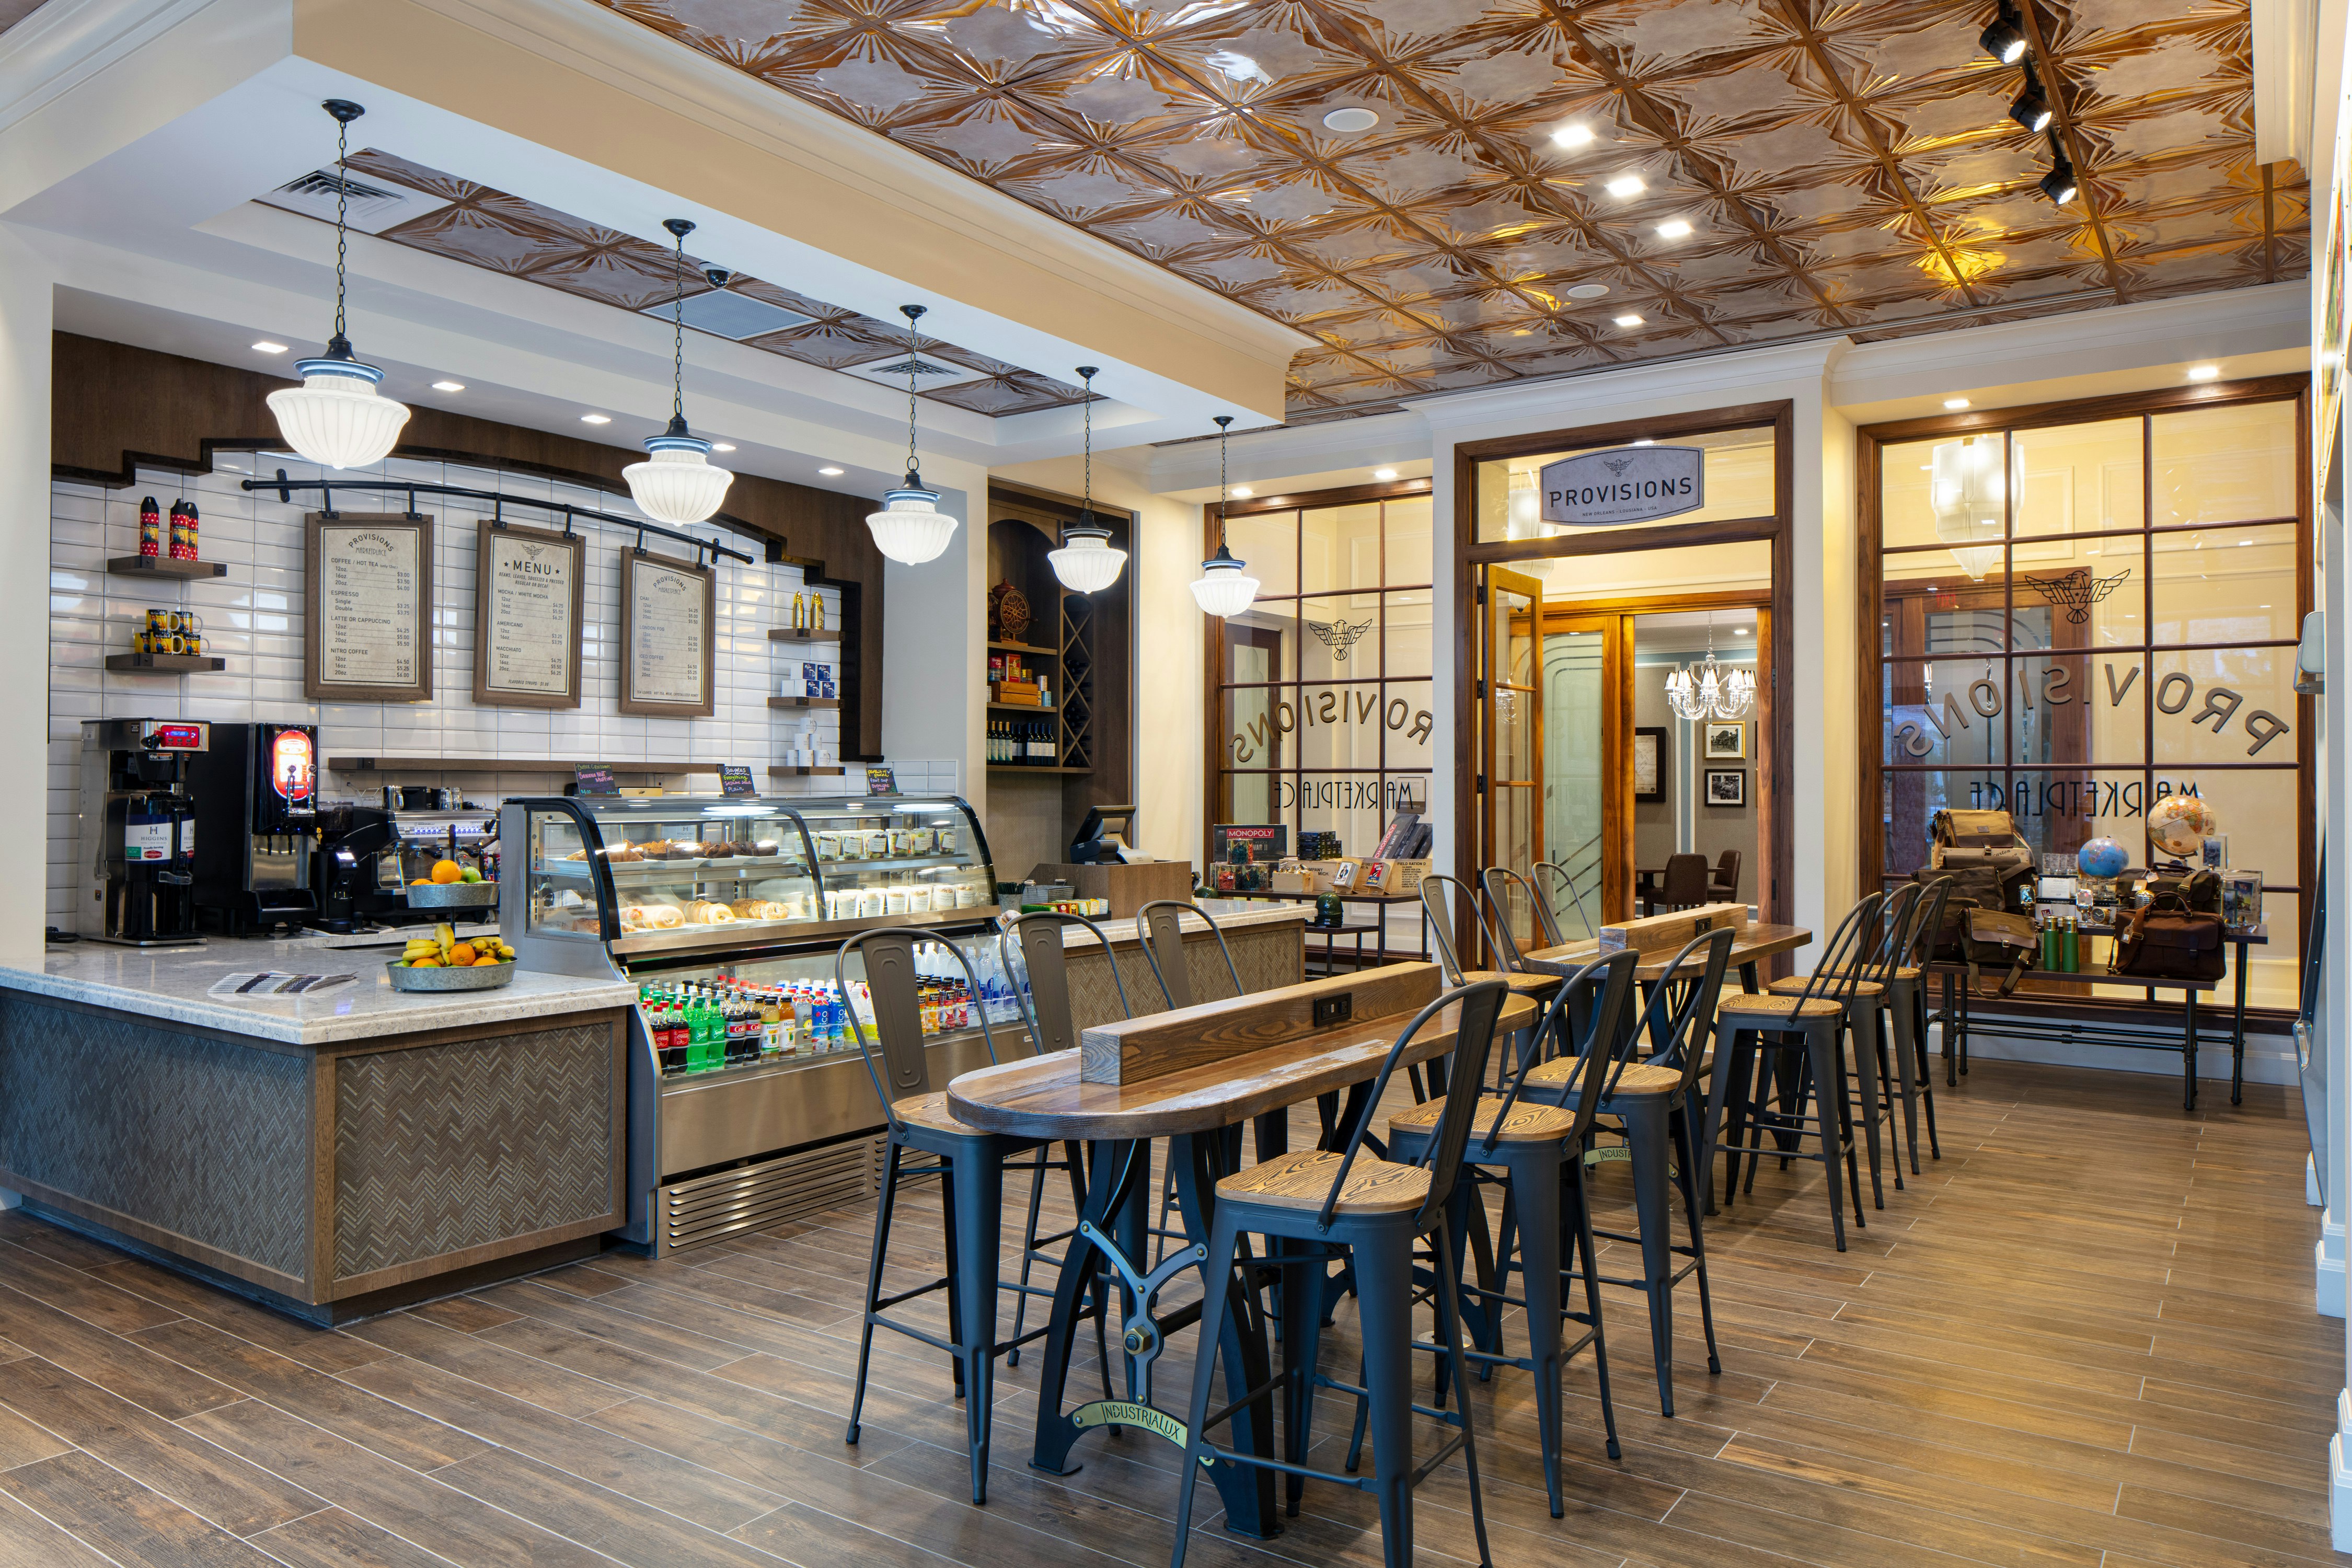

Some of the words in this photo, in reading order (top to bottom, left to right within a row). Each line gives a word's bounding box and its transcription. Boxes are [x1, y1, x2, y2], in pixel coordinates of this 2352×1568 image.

[1549, 477, 1692, 508] PROVISIONS
[349, 534, 394, 552] PROVISIONS
[355, 547, 386, 556] MARKETPLACE
[514, 560, 551, 575] MENU
[653, 576, 686, 592] PROVISIONS
[1375, 825, 1395, 859] ONOPOLY
[1599, 1149, 1631, 1161] INDUST
